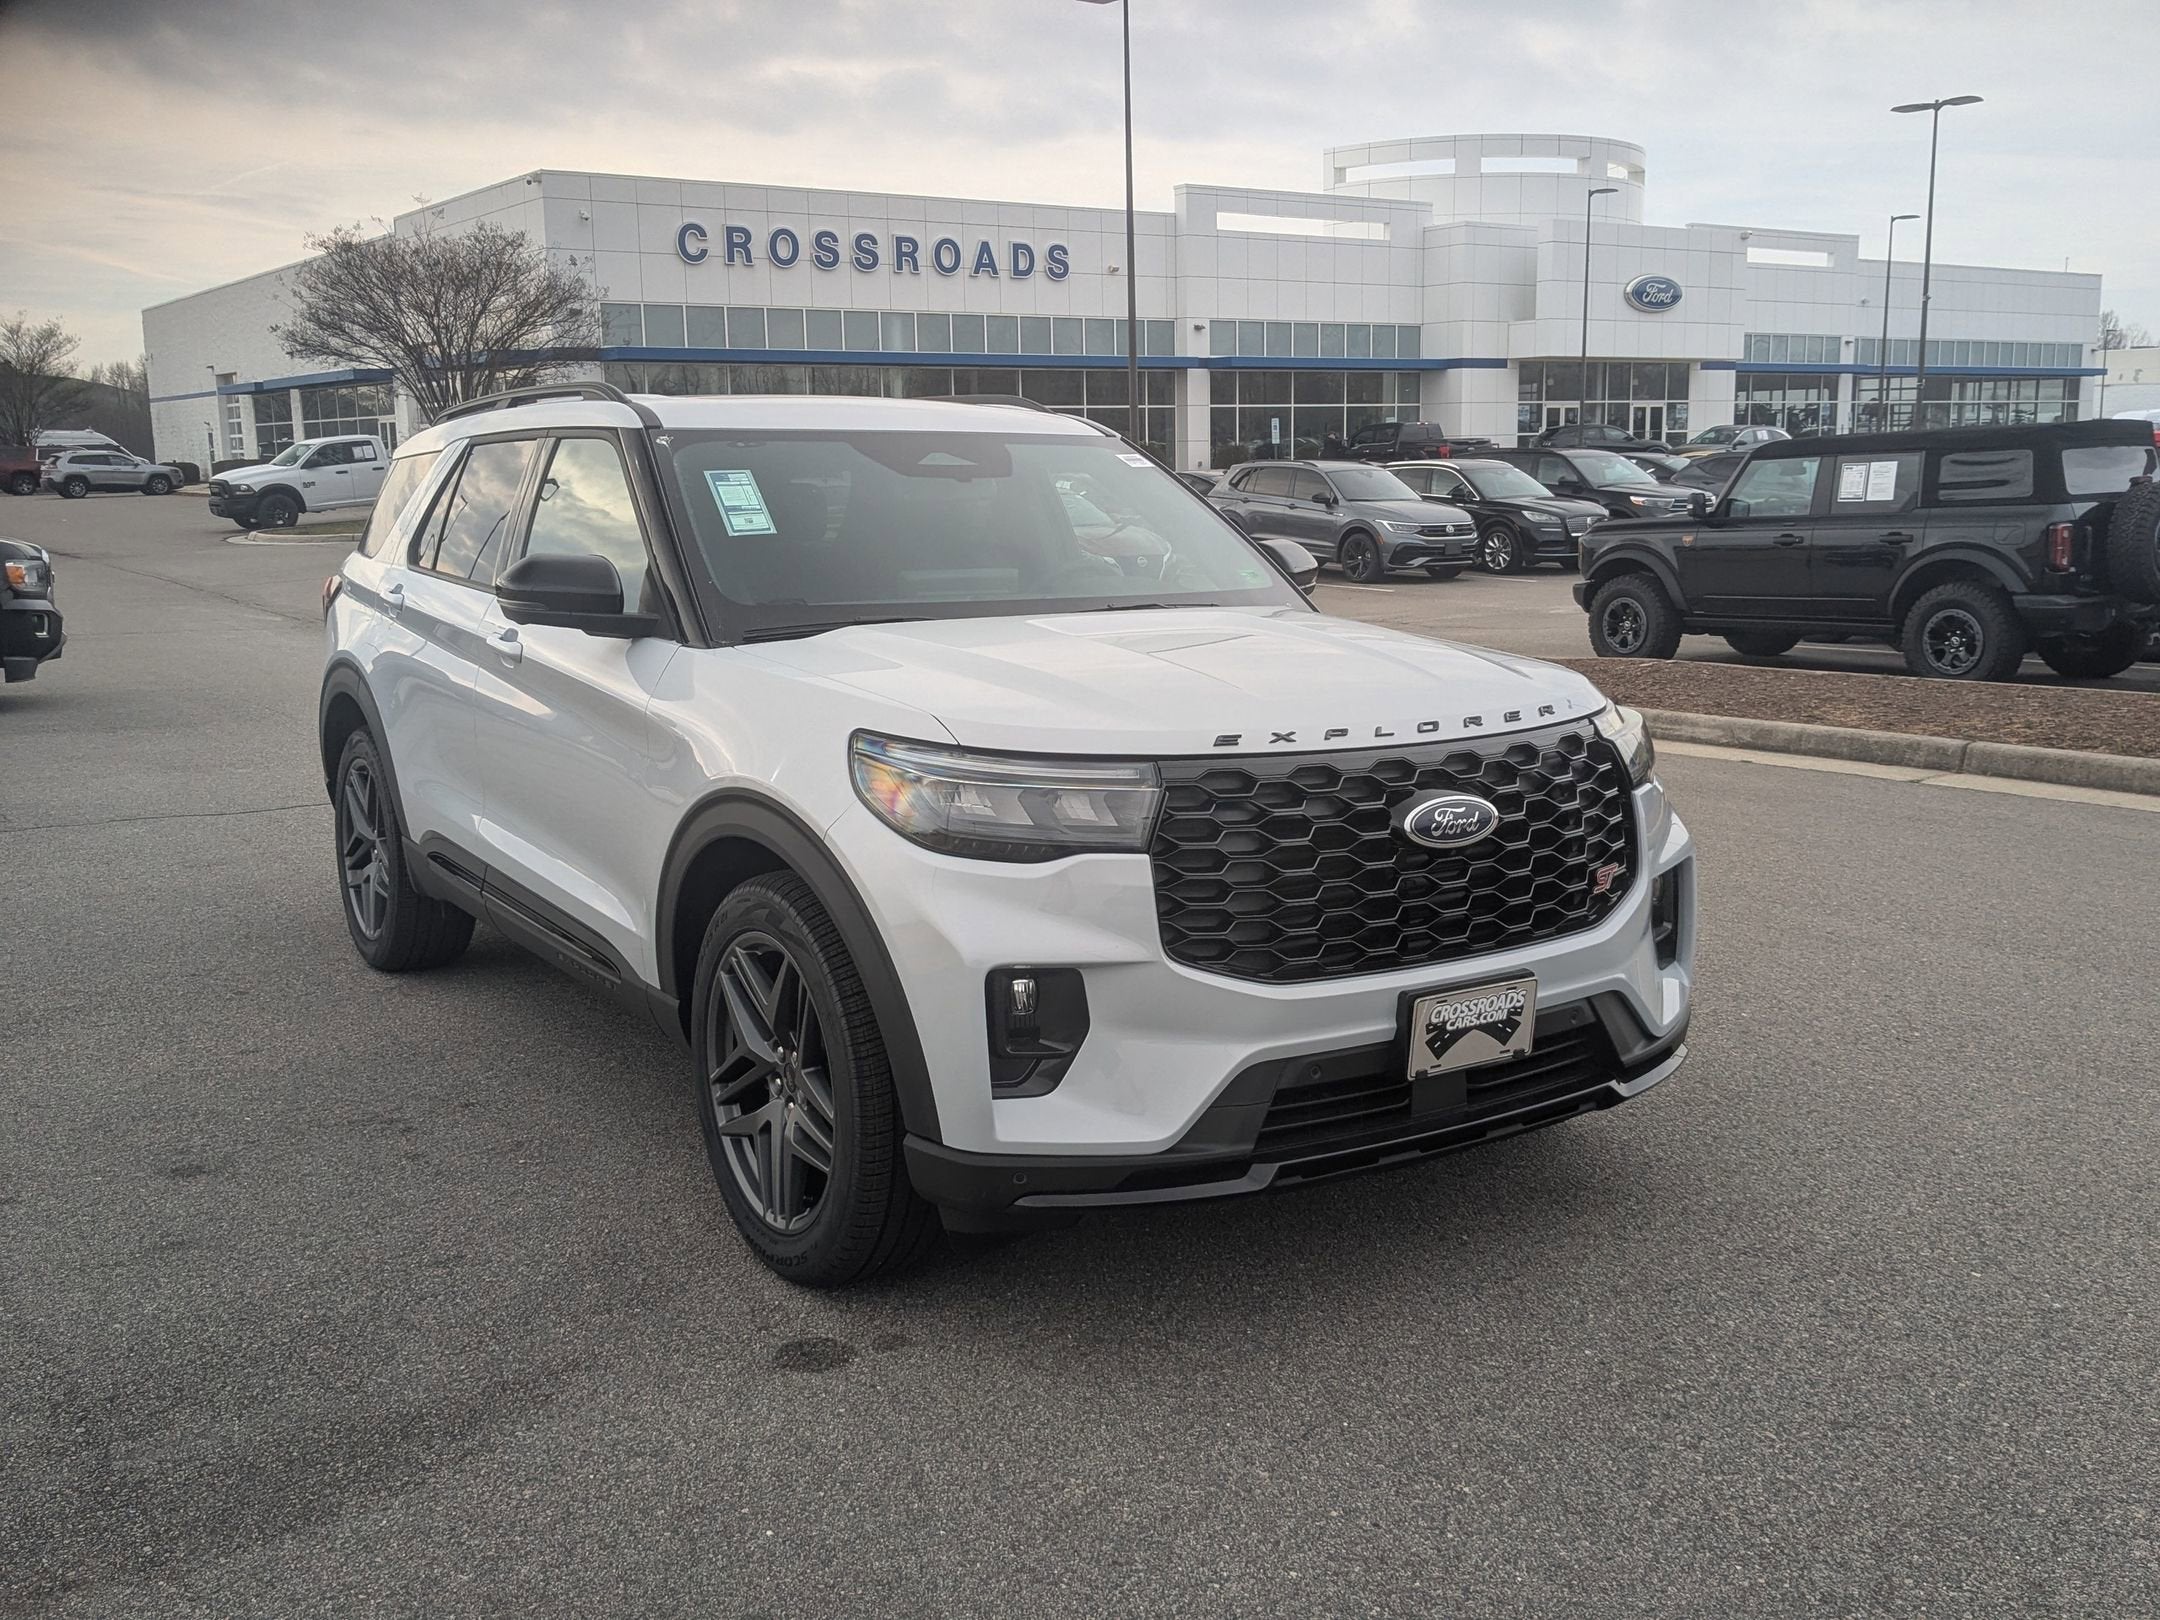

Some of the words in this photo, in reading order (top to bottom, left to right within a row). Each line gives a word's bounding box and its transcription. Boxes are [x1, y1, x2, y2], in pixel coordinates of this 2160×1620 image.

[676, 221, 1071, 281] CROSSROADS
[1642, 282, 1674, 304] Ford
[1213, 703, 1556, 747] EXPLORER
[1431, 806, 1480, 837] Ford
[1593, 862, 1619, 894] ST
[1430, 988, 1528, 1024] CROSSROADS
[1445, 1008, 1509, 1032] CARS.COM
